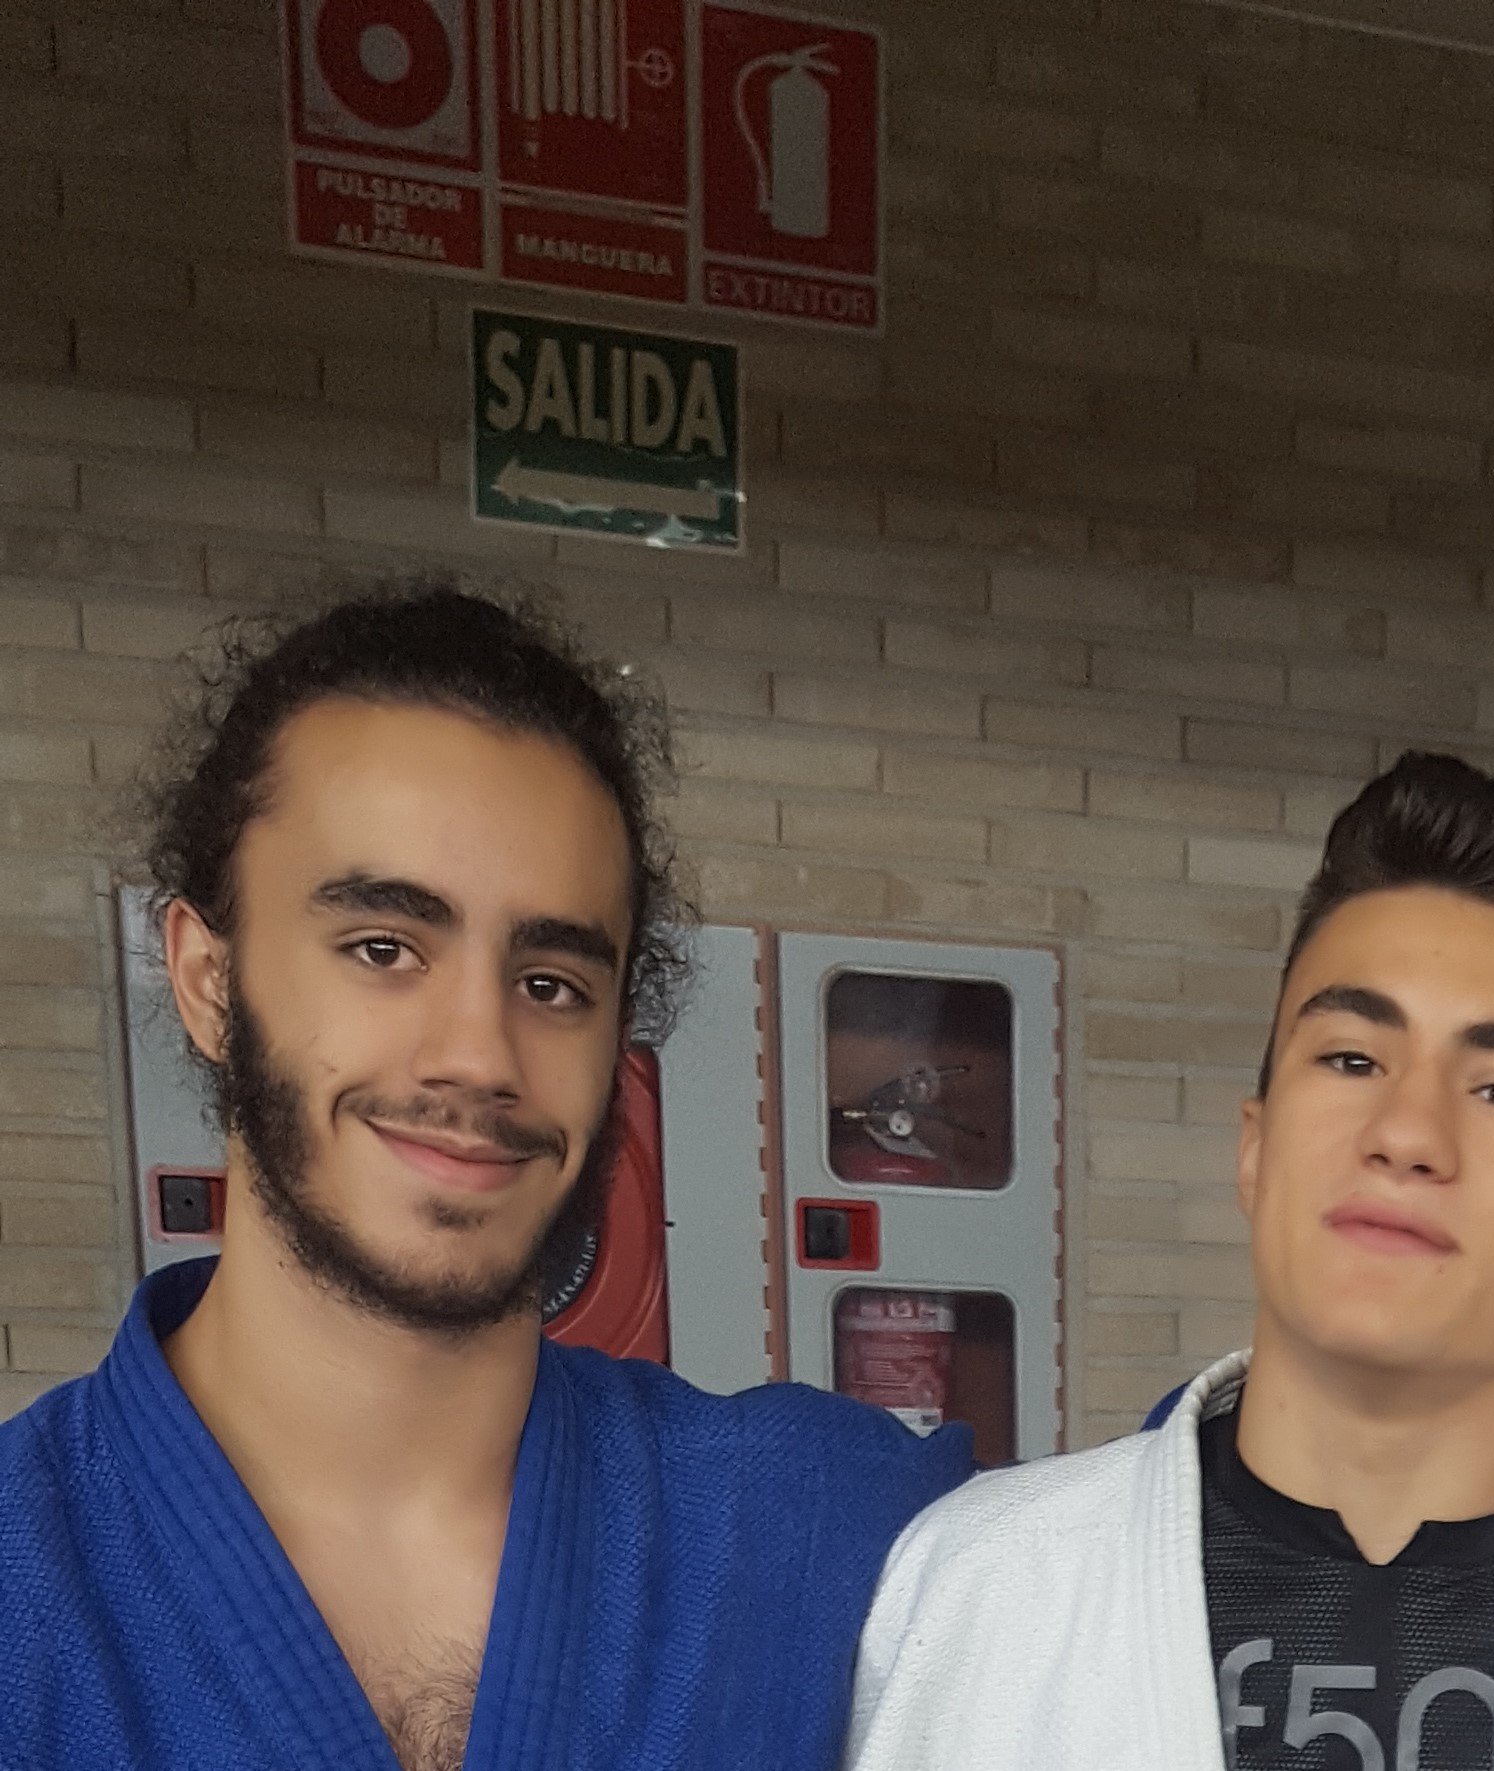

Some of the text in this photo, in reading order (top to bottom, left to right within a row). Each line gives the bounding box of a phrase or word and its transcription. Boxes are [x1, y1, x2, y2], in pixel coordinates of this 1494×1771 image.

[316, 170, 463, 212] PULSADOR
[372, 204, 408, 231] DE
[334, 223, 448, 262] ALARMA
[515, 232, 674, 279] MANGUERA
[708, 270, 873, 320] EXTINTOR
[484, 328, 728, 459] SALIDA
